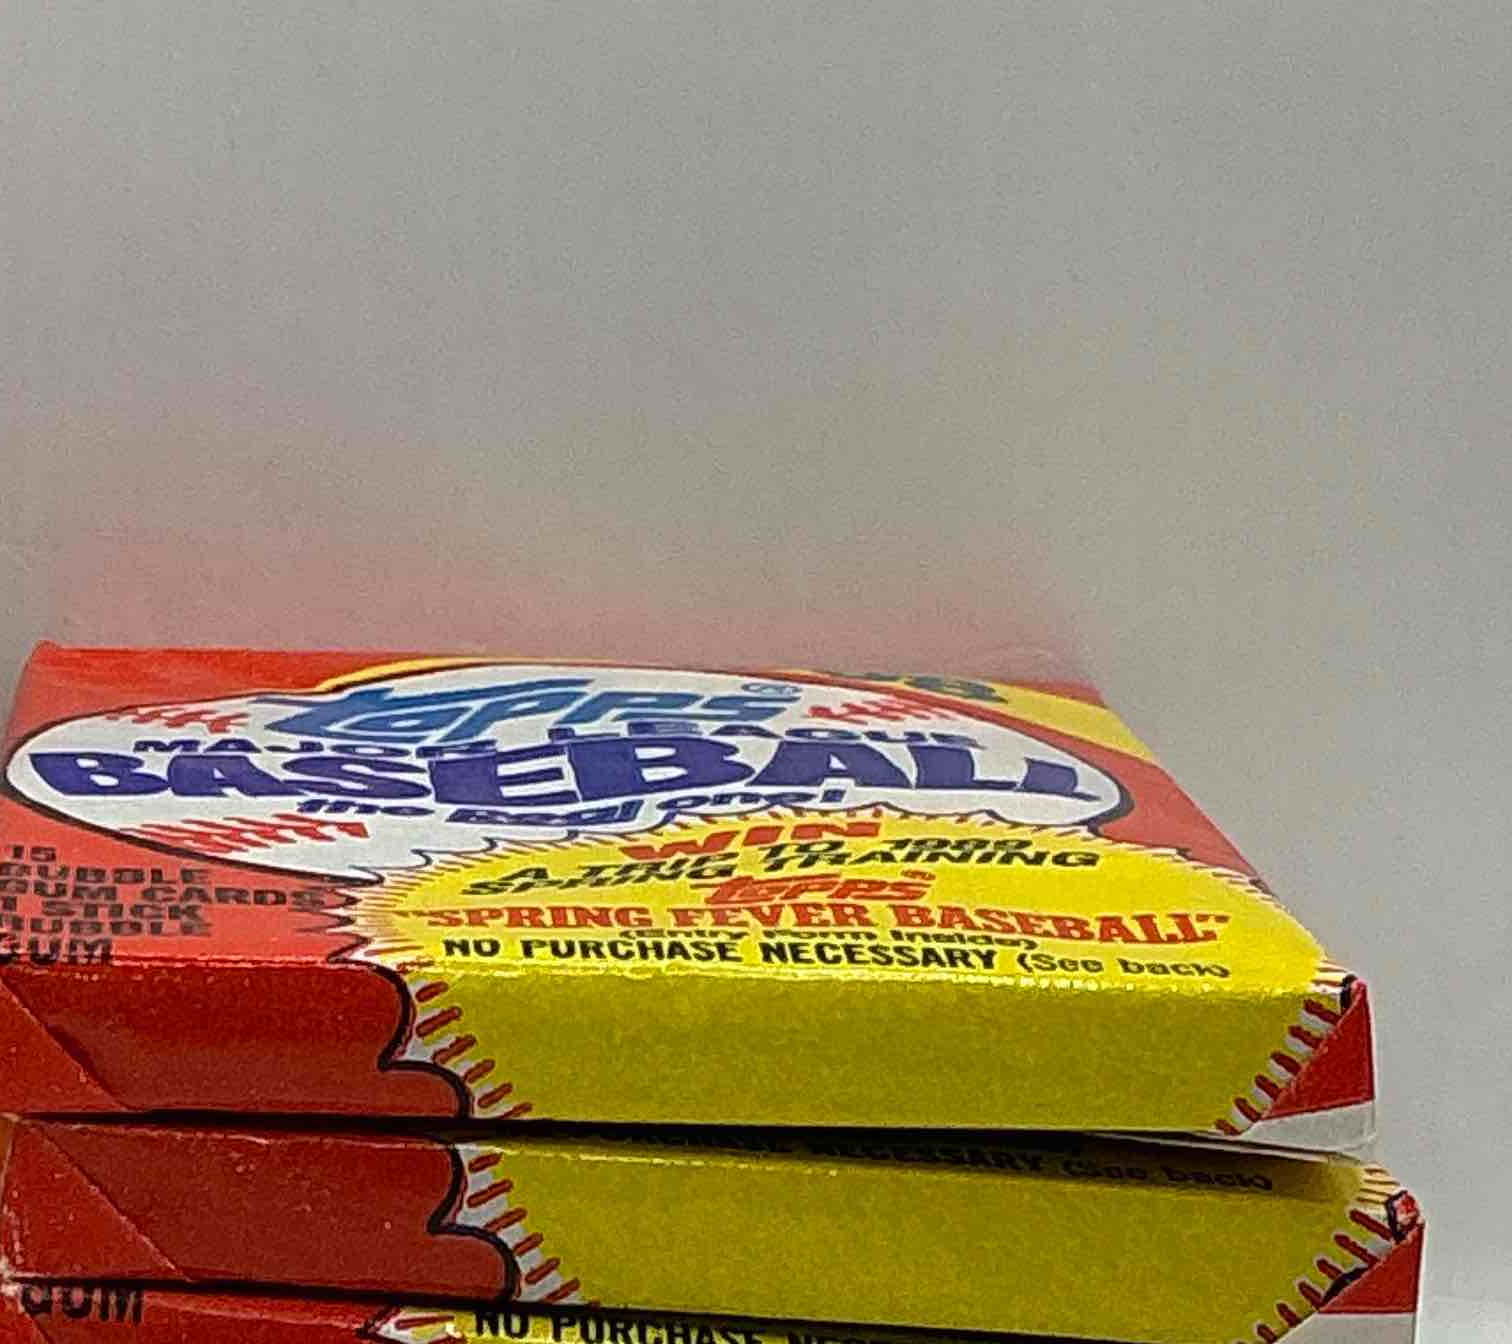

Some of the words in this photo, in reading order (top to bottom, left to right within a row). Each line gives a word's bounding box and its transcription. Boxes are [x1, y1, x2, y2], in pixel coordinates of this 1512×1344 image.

[30, 736, 1101, 805] BASEBALL
[619, 821, 881, 860] WIN
[668, 902, 875, 928] FEVER
[888, 904, 1230, 944] BASEBALL"
[443, 938, 500, 957] NO
[521, 938, 742, 963] PURCHASE
[760, 941, 997, 970] NECESSARY
[474, 1311, 530, 1340] NO
